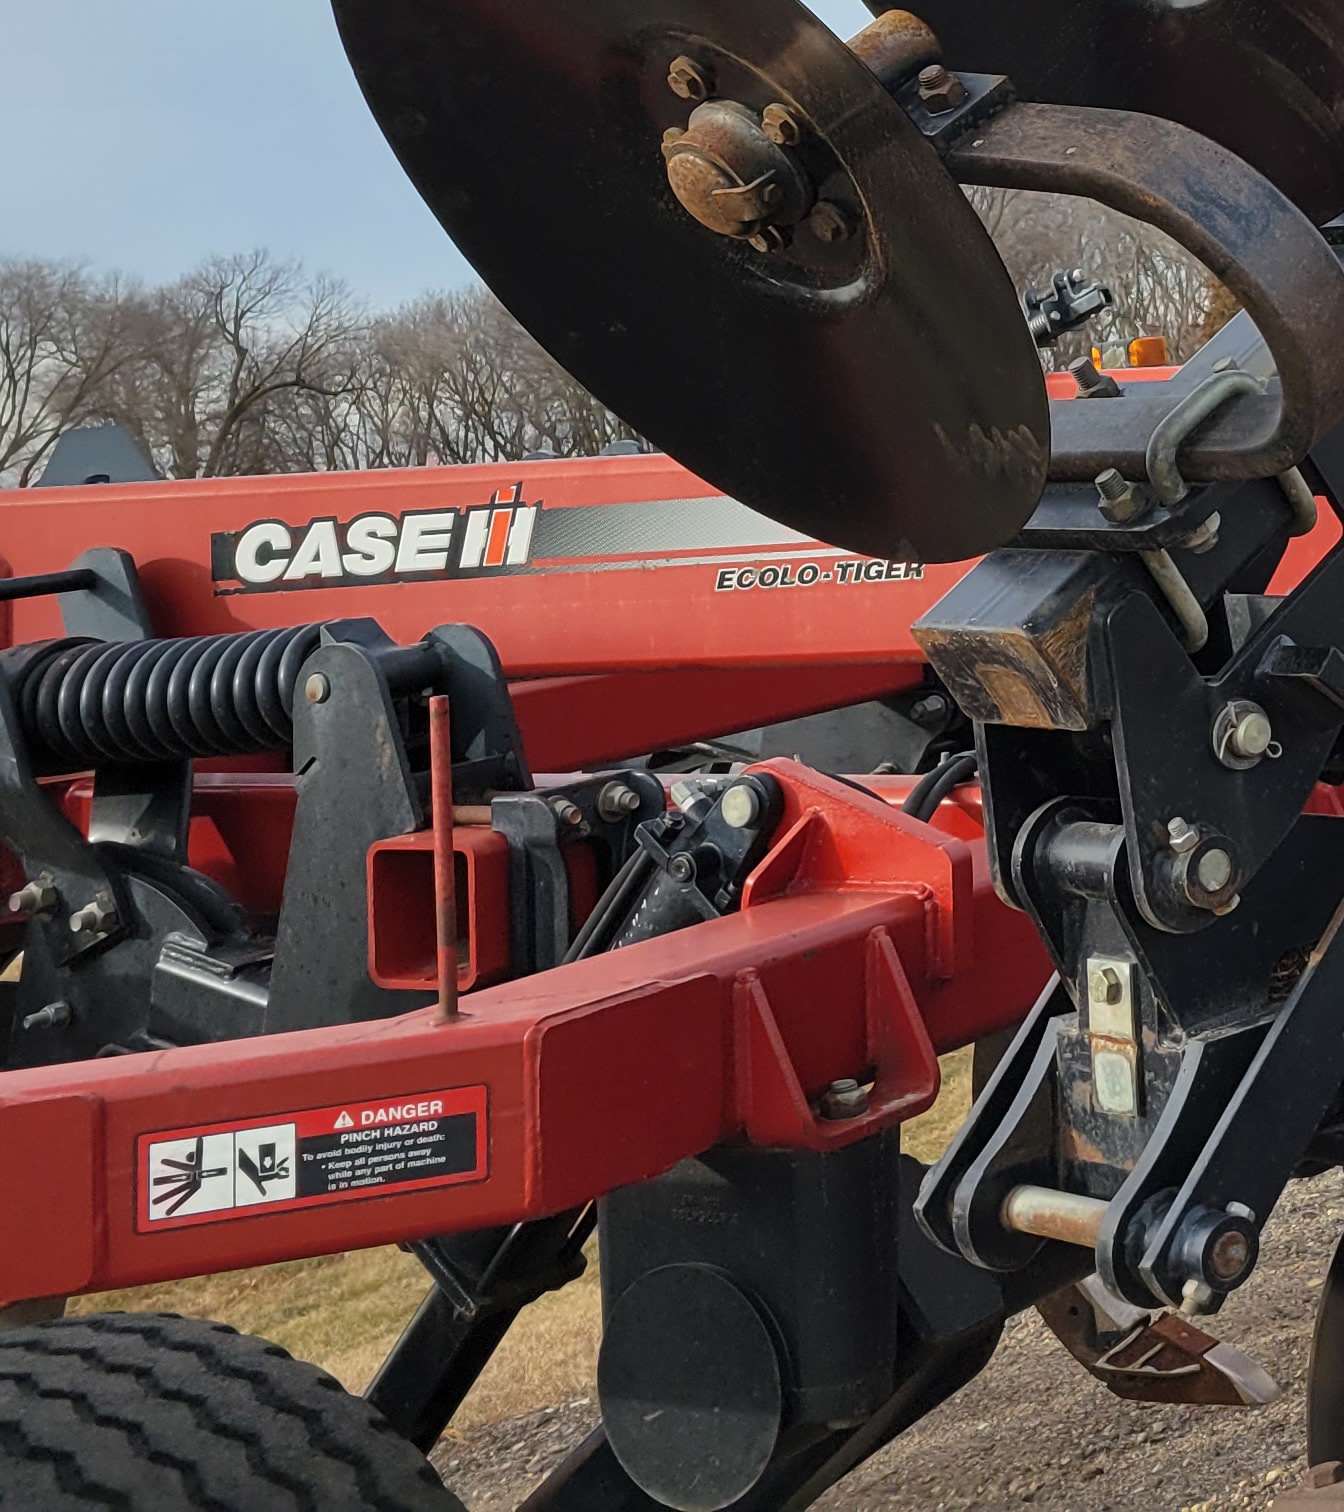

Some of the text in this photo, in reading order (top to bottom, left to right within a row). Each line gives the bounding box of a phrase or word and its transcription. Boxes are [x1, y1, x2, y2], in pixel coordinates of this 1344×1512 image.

[234, 512, 456, 584] CASE
[714, 560, 925, 592] ECOLO-TIGER
[361, 1101, 442, 1125] DANGER
[341, 1121, 438, 1144] PINCH HAZARD
[302, 1134, 446, 1161] To avoid bodily injury or death:
[328, 1148, 431, 1169] Keep all persons away
[328, 1156, 446, 1180] while any part of machine
[328, 1176, 385, 1191] is in motion.
